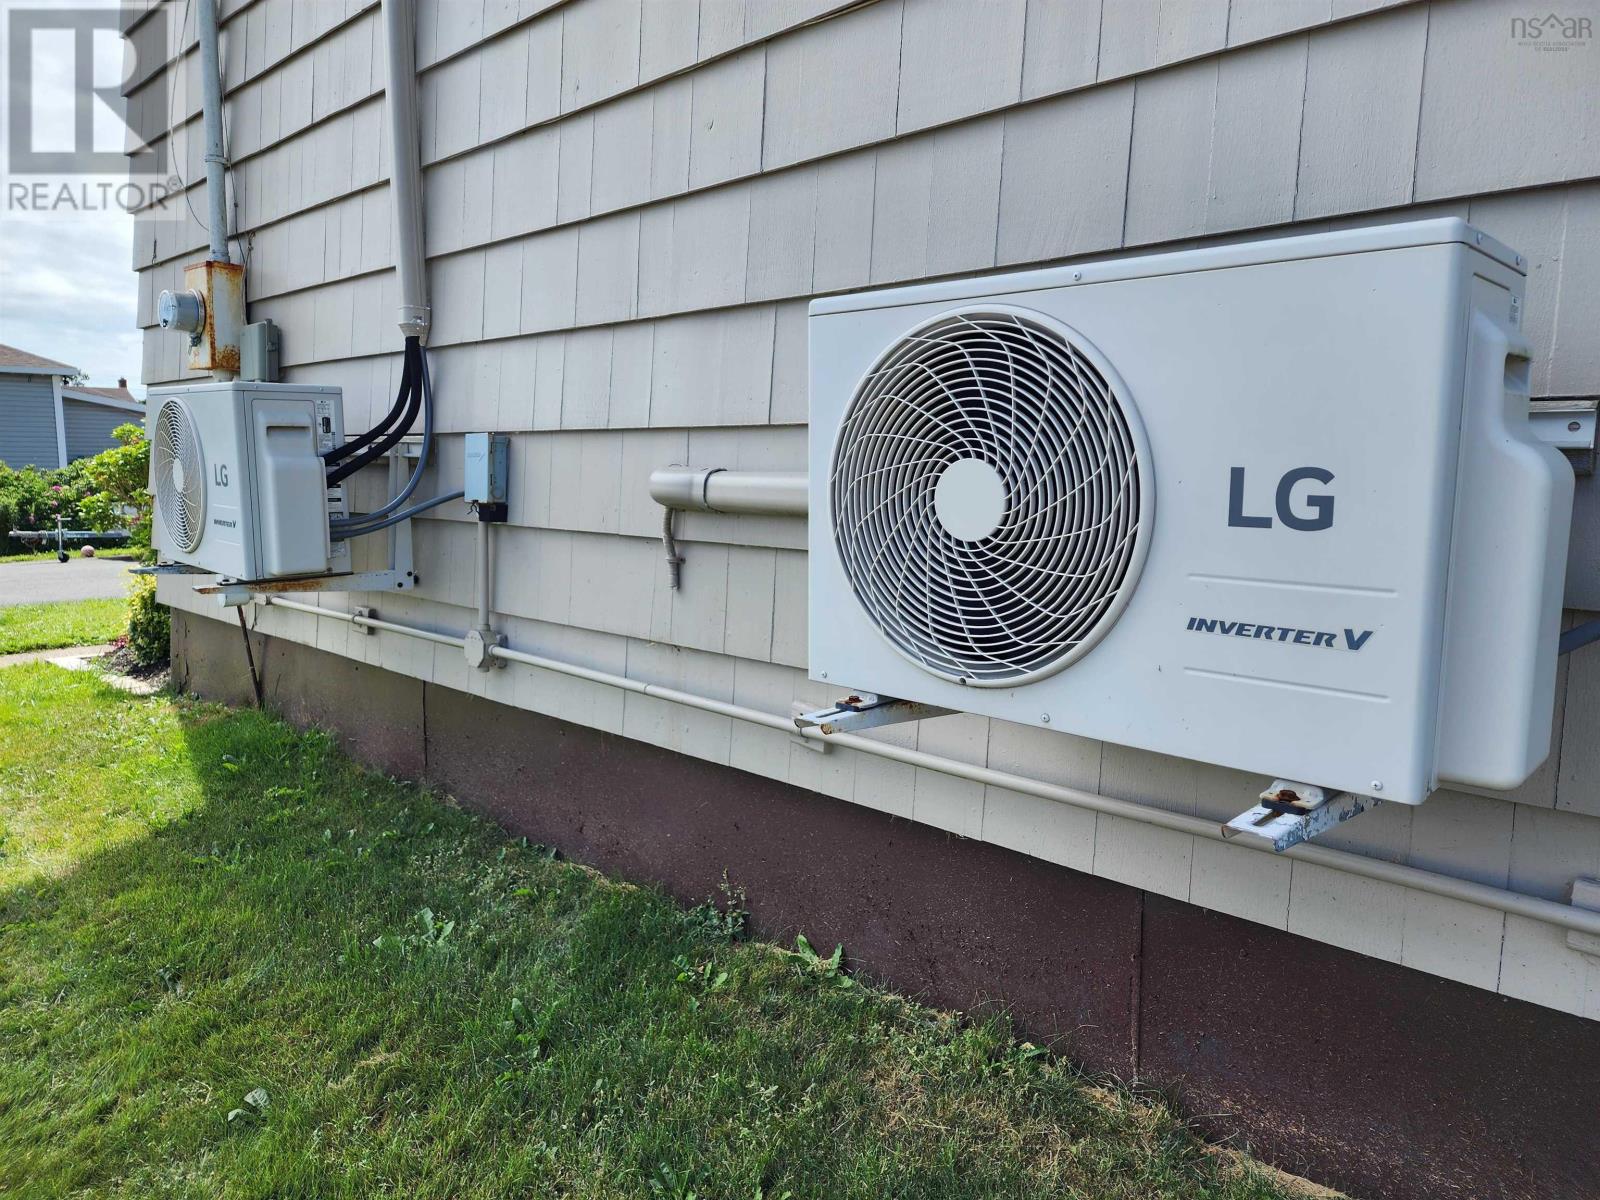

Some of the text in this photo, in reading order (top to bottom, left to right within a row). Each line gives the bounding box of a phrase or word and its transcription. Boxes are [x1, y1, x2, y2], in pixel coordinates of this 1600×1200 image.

[214, 464, 229, 488] LG
[1228, 467, 1335, 531] LG
[1186, 617, 1373, 651] INVERTER V
